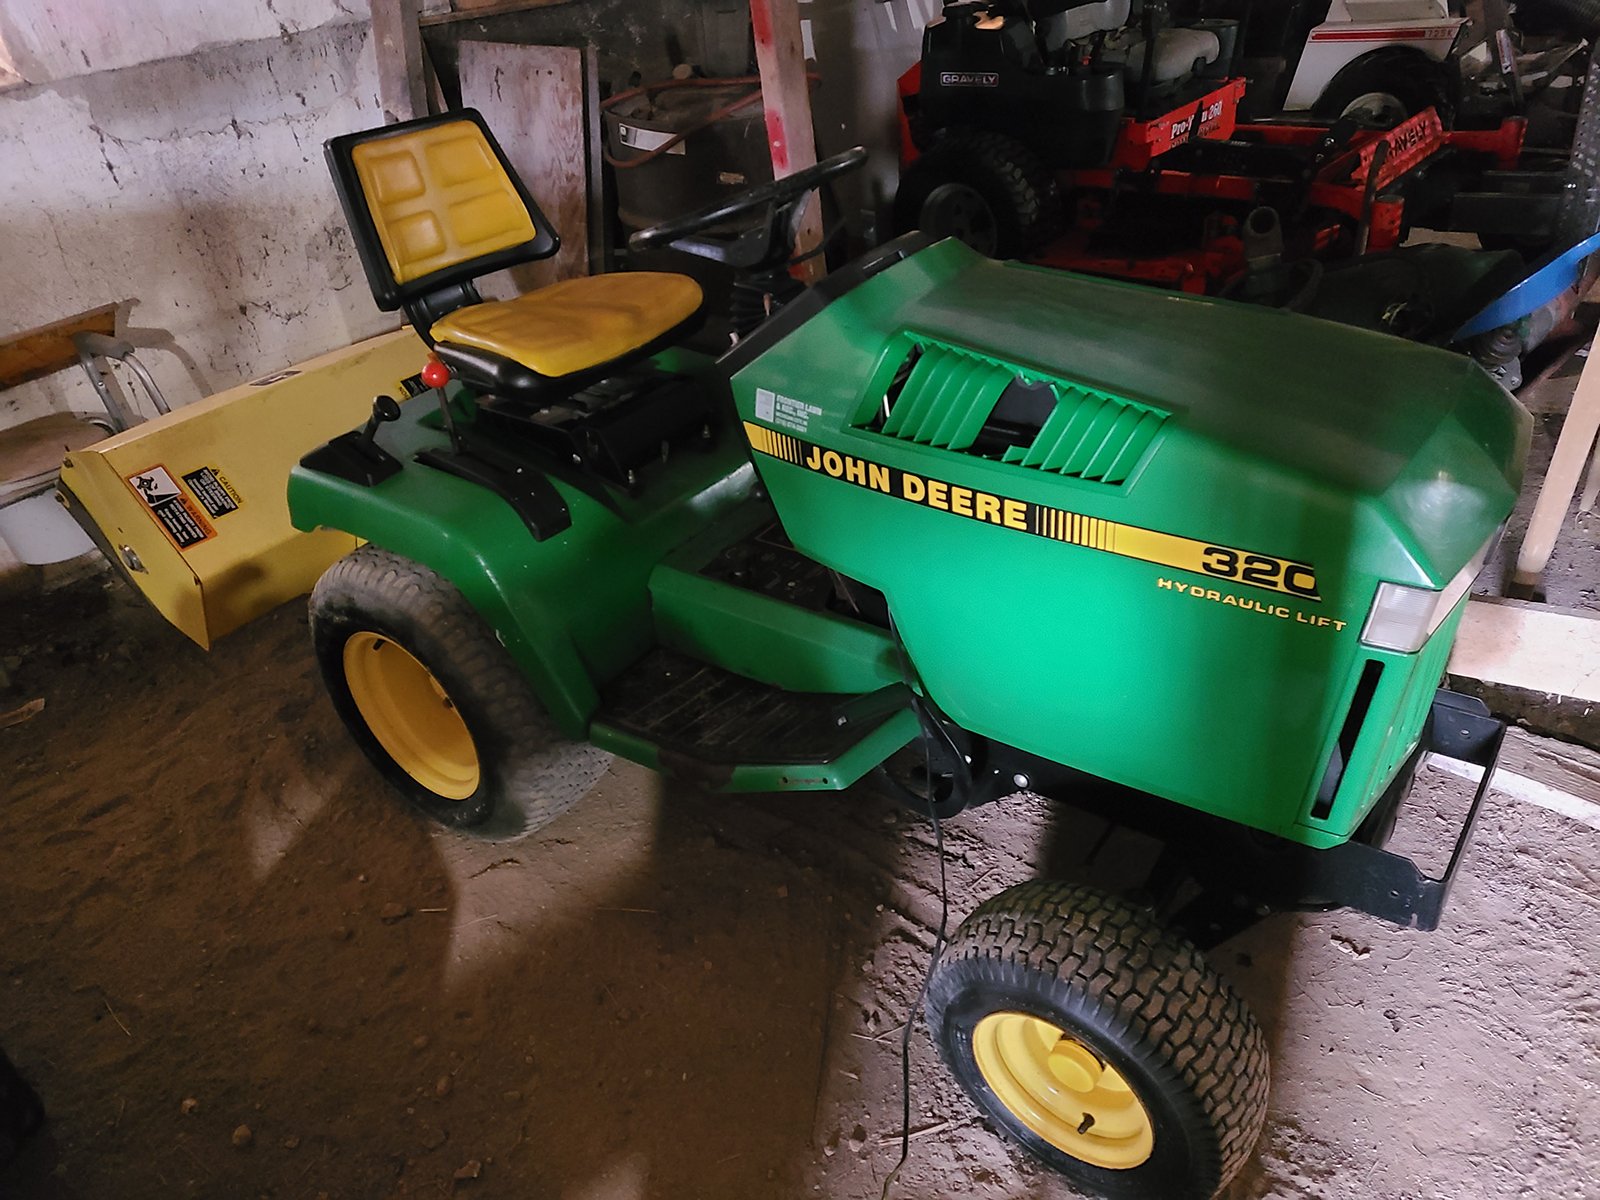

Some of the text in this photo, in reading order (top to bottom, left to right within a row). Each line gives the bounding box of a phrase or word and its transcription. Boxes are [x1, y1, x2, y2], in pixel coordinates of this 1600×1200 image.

[942, 74, 997, 84] GRAVELY
[219, 476, 243, 503] CAUTION
[806, 446, 1027, 531] JOHN DEERE
[186, 505, 212, 535] WARNING
[1202, 547, 1320, 597] 320
[1157, 577, 1347, 631] HYDRAULIC LIFT
